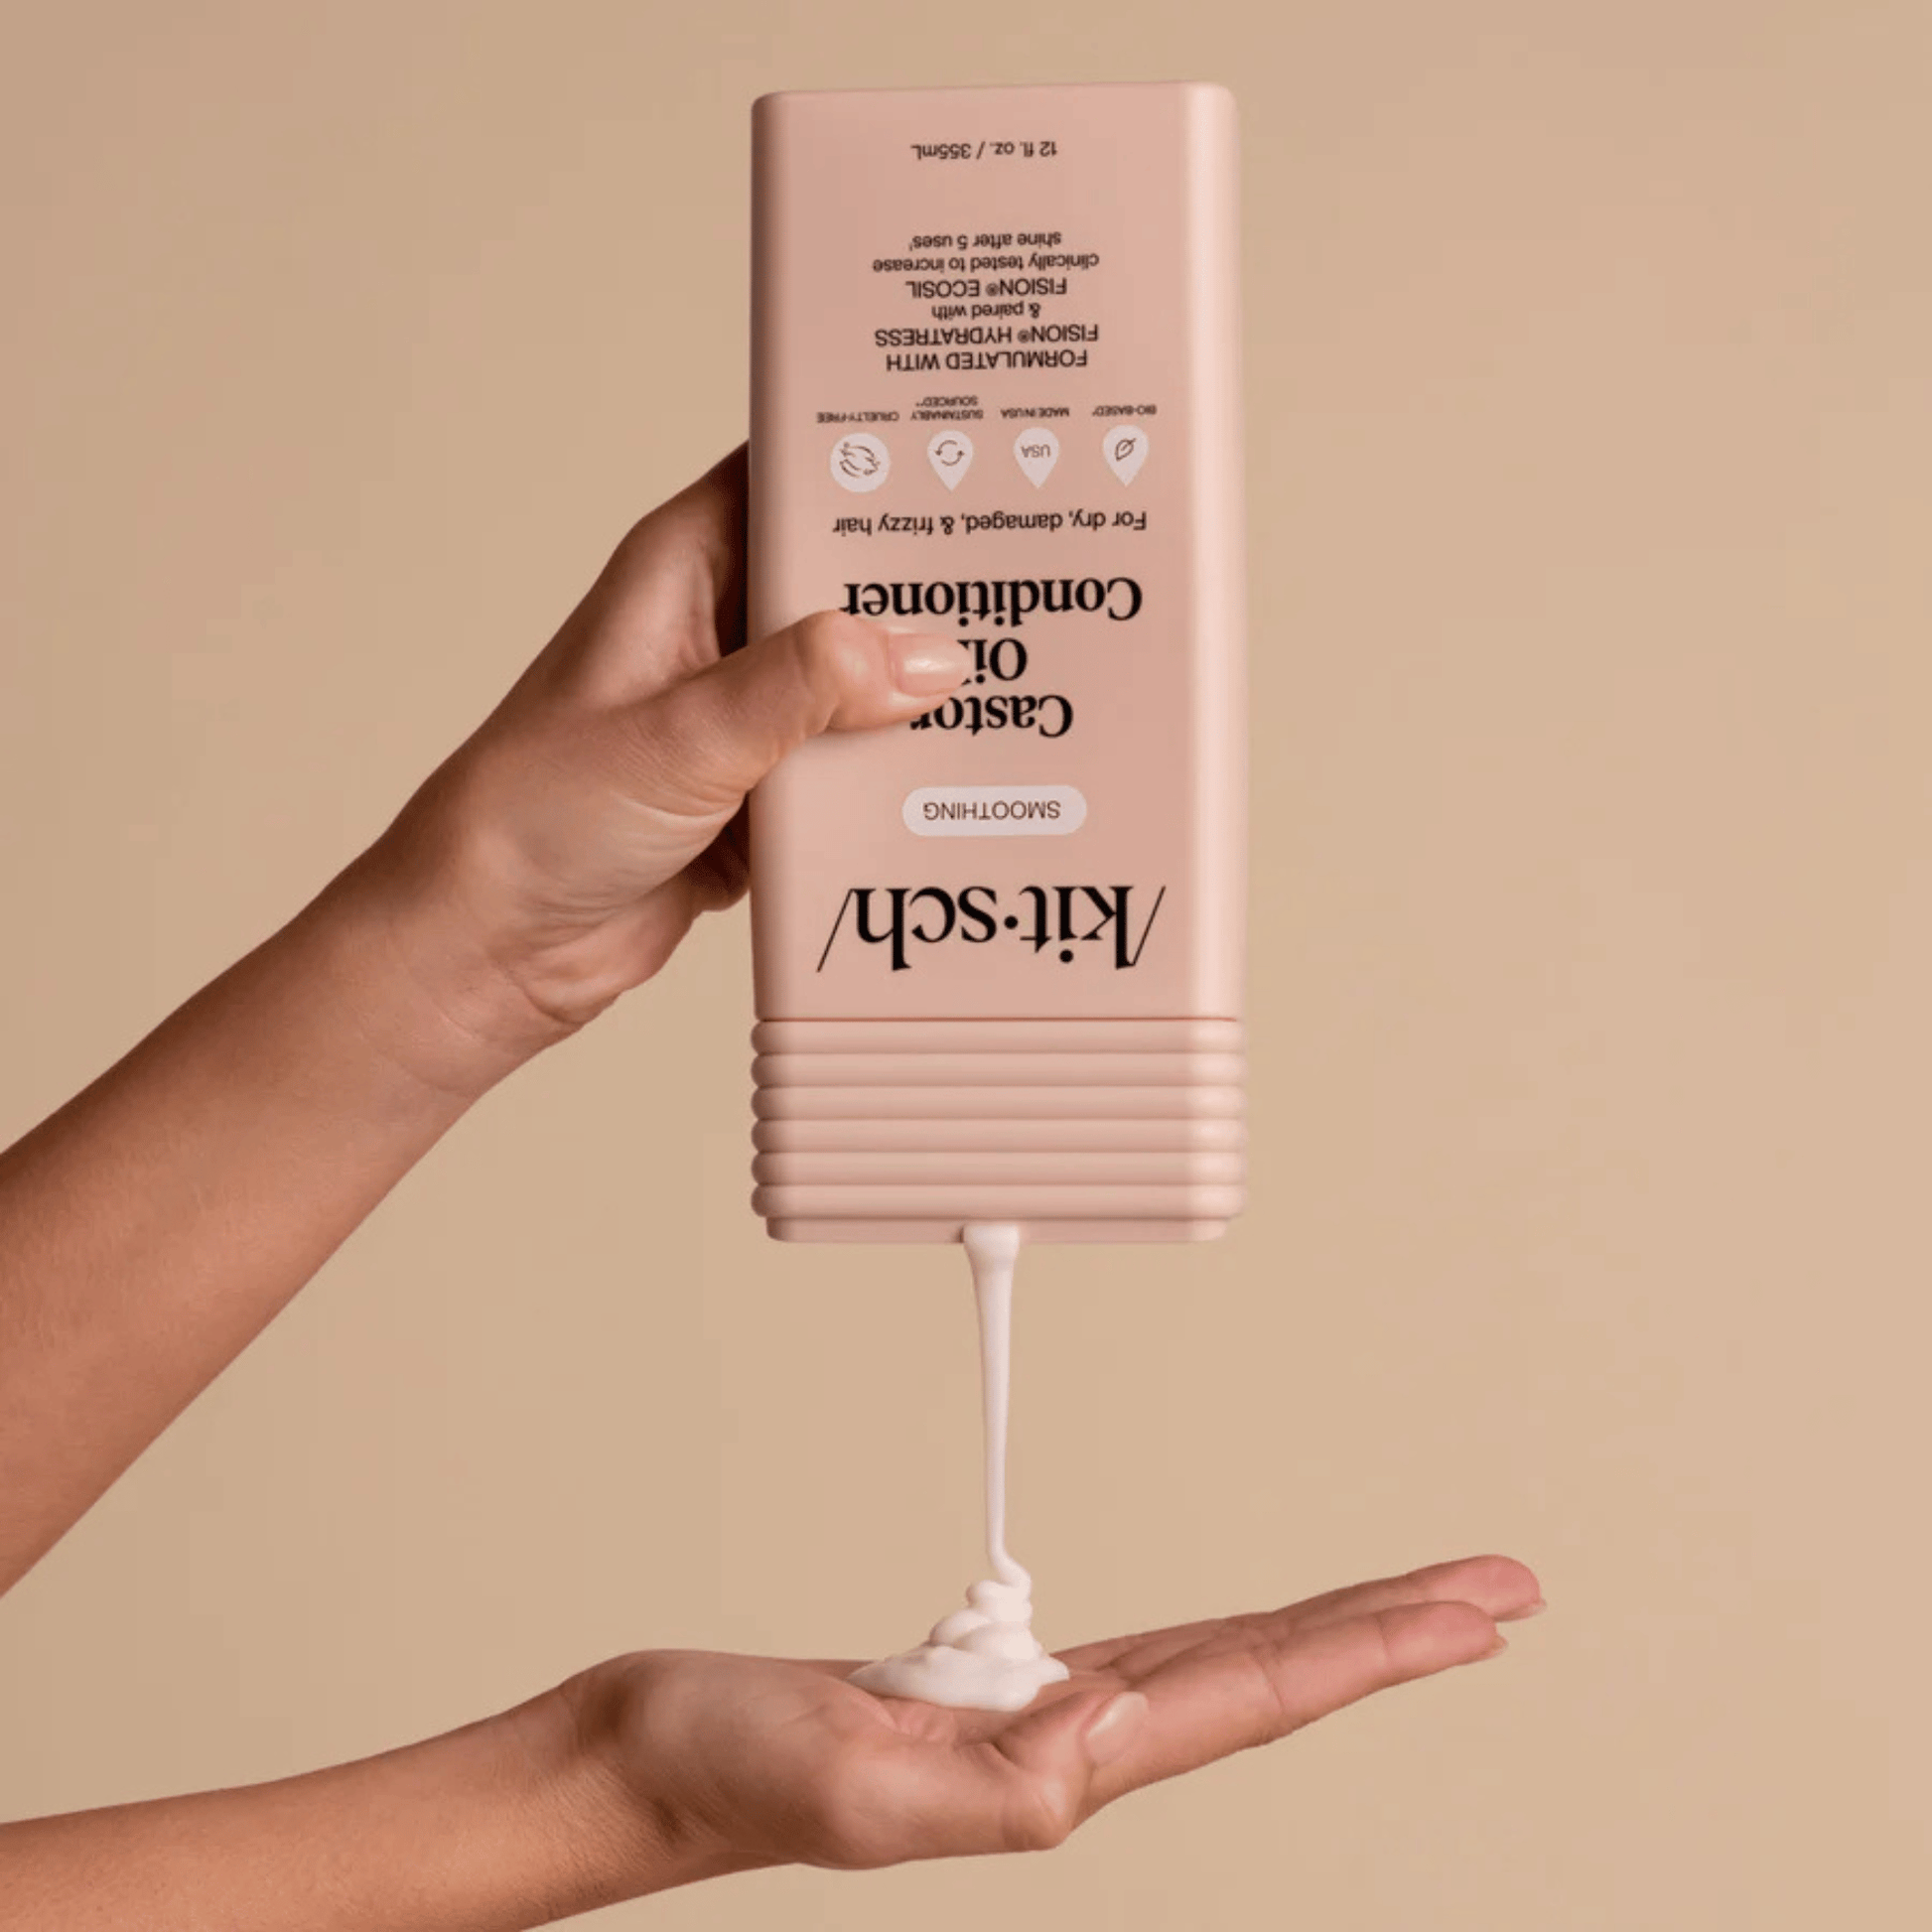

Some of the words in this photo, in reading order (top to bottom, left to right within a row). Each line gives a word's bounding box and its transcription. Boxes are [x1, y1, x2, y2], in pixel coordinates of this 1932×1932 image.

[909, 142, 973, 162] 355mL
[975, 140, 987, 161] /
[988, 141, 1017, 157] oz.
[1019, 141, 1035, 159] fl.
[1037, 140, 1058, 159] 12
[957, 234, 969, 251] 5
[973, 232, 1014, 249] after
[1016, 230, 1063, 249] shine
[871, 257, 945, 274] increase
[947, 256, 967, 273] to
[969, 255, 1025, 273] tested
[1028, 252, 1101, 273] clinically
[903, 278, 982, 300] ECOSIL
[930, 304, 968, 322] with
[970, 301, 1026, 321] paired
[1028, 302, 1042, 320] &
[873, 327, 1014, 348] HYDRATRESS
[886, 353, 941, 372] WITH
[945, 349, 1087, 369] FORMULATED
[815, 410, 900, 425] CRUELTY-FREE
[908, 408, 986, 422] SUSTAINABLY
[999, 408, 1024, 421] USA
[1025, 407, 1036, 419] IN
[1037, 406, 1070, 418] MADE
[1021, 443, 1051, 460] USA
[831, 515, 873, 538] hair
[877, 511, 935, 537] frizzy
[938, 514, 956, 537] &
[960, 509, 1064, 536] damaged,
[1067, 507, 1107, 534] dry,
[1111, 509, 1148, 533] For
[839, 577, 1144, 627] Conditioner
[956, 637, 1029, 686] Oi
[922, 799, 1062, 821] SMOOTHING
